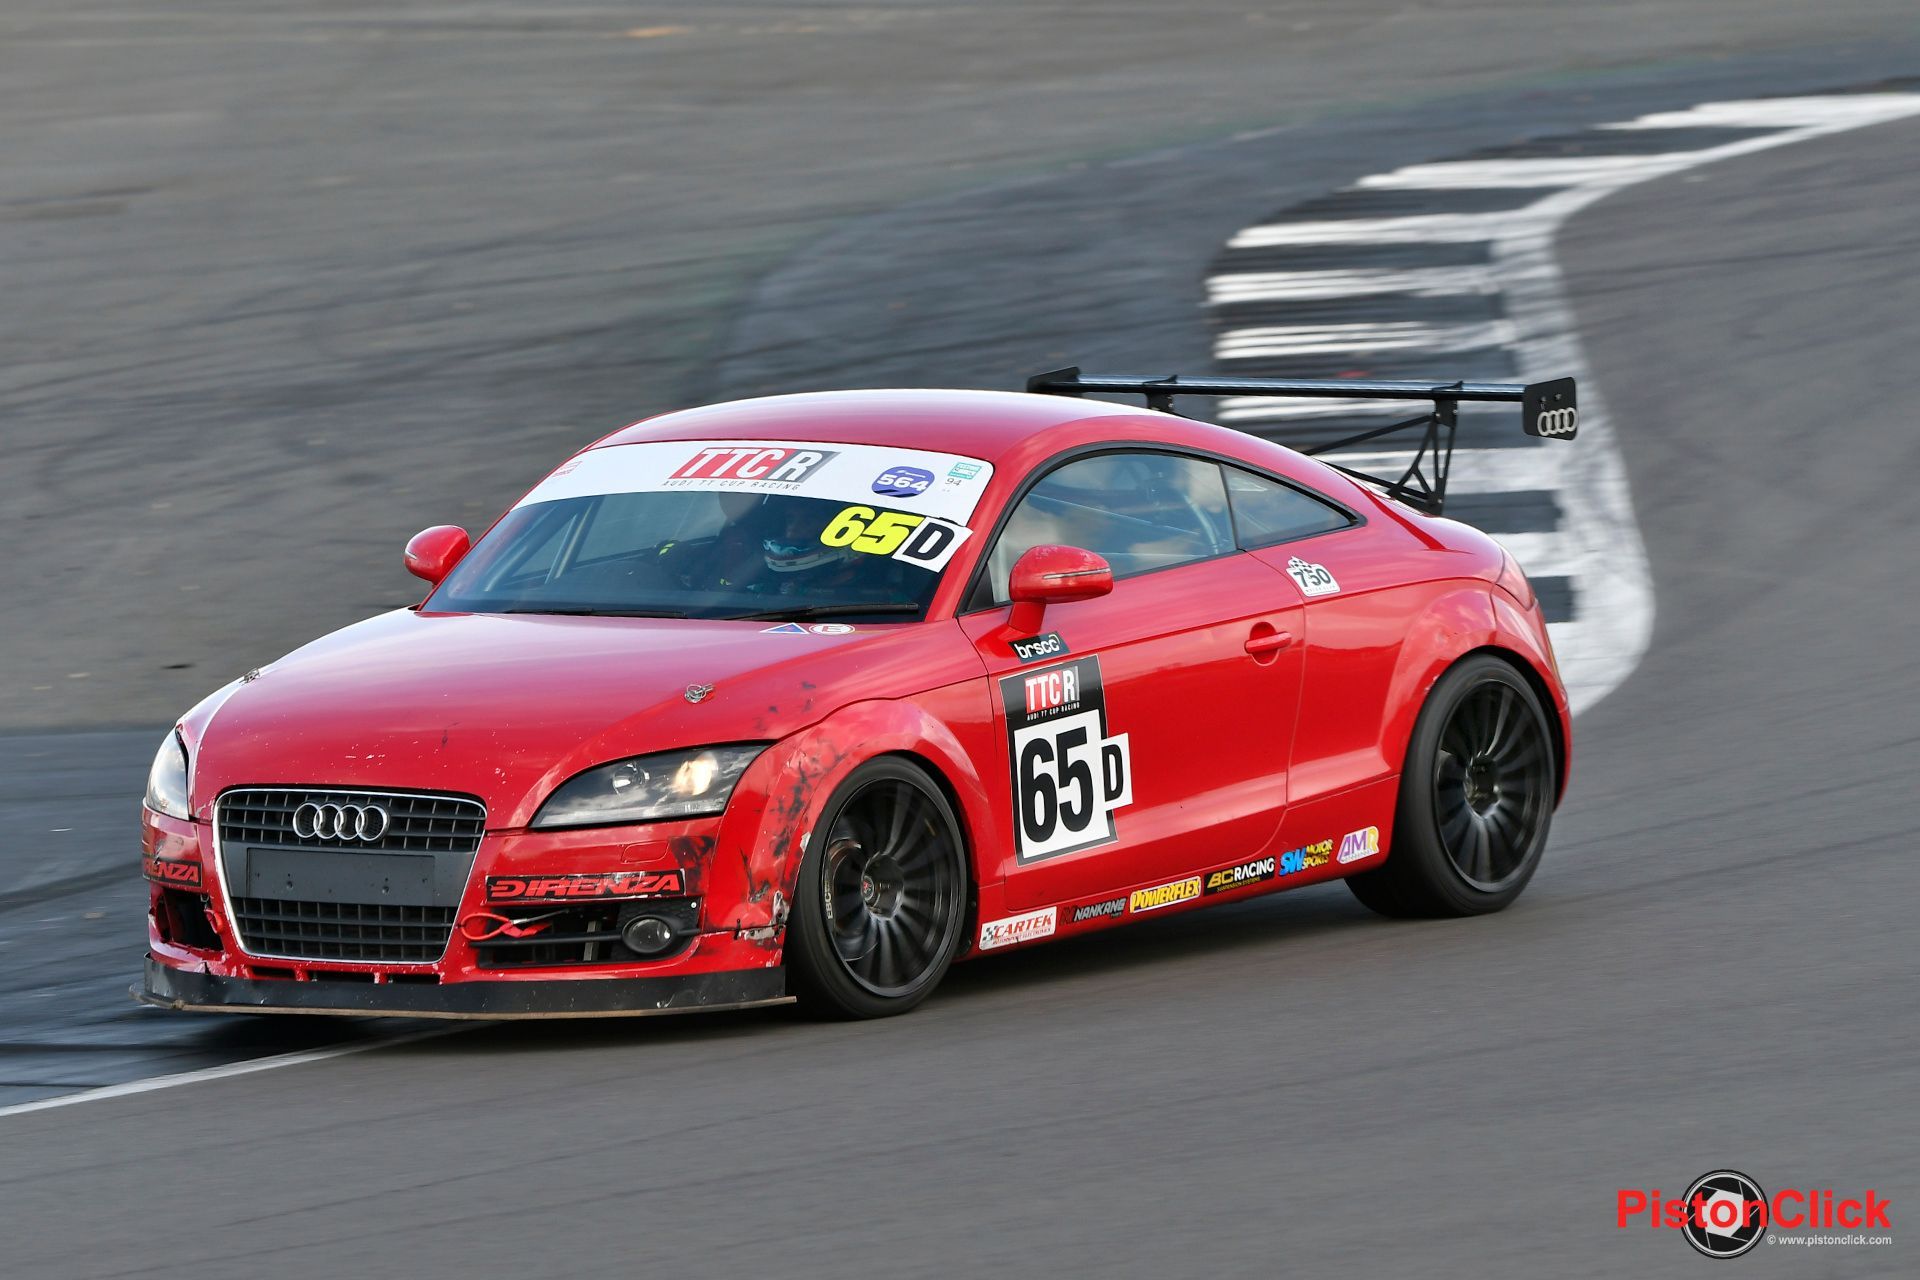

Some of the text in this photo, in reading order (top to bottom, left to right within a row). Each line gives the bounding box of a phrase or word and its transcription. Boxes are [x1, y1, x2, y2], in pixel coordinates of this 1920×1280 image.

[681, 448, 823, 481] TTCR
[662, 479, 693, 487] AUDI
[750, 481, 801, 491] RACING
[876, 473, 929, 492] 564
[820, 505, 955, 561] 65 D
[1293, 568, 1331, 587] 750
[1014, 635, 1060, 659] brscc
[1025, 669, 1076, 711] TTCR
[1027, 712, 1039, 720] AUDI
[1049, 707, 1059, 716] CUP
[1061, 701, 1080, 713] RACING
[1020, 726, 1124, 843] 65 D
[1338, 828, 1378, 860] AMR
[1279, 847, 1307, 876] SW
[491, 874, 681, 898] DIRENZA
[1131, 880, 1199, 911] POWERFLEX
[1073, 898, 1127, 922] NANKANG
[993, 912, 1053, 939] CARTEK
